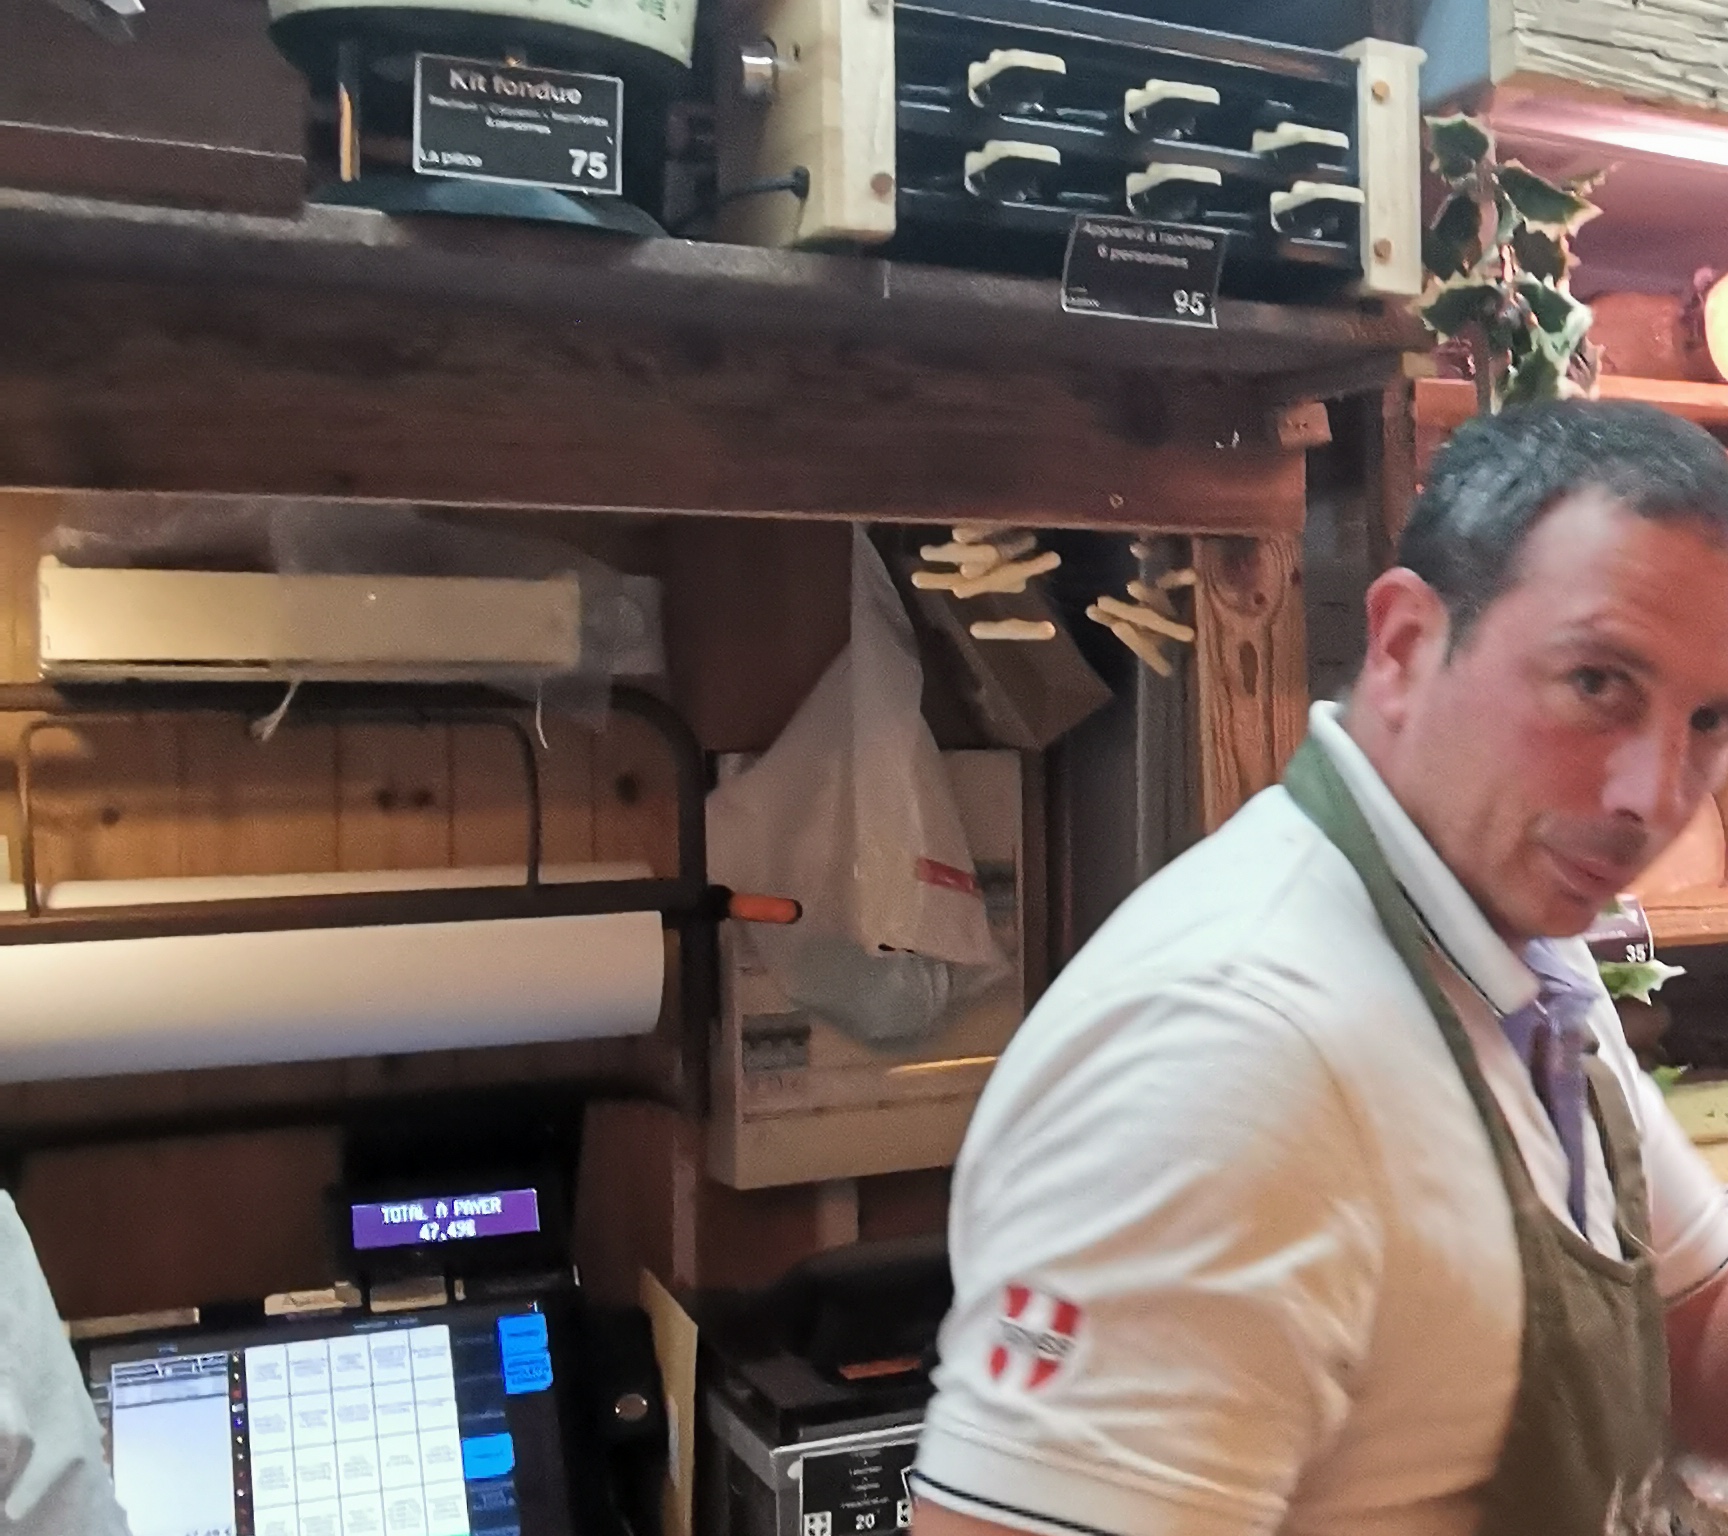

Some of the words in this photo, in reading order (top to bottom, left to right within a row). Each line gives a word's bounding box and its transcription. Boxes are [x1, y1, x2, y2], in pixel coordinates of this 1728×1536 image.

[450, 68, 488, 94] Kit
[492, 73, 583, 106] fondue
[568, 148, 609, 180] 75
[1172, 288, 1206, 317] 95
[381, 1203, 429, 1224] TOTAL
[453, 1196, 502, 1217] PAYER
[855, 1512, 876, 1531] 20
